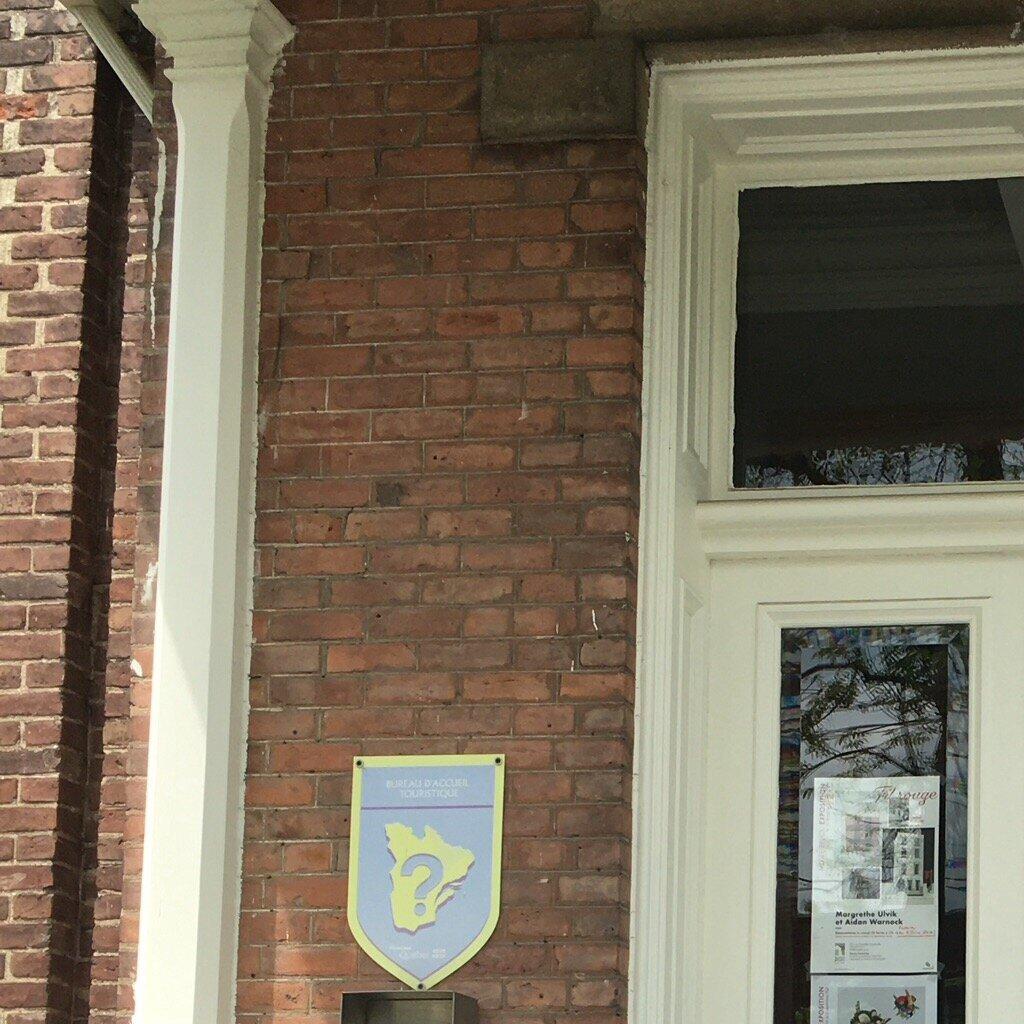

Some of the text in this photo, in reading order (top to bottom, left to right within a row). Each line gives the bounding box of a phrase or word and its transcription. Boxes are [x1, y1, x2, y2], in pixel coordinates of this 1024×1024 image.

[386, 778, 469, 789] BUREAU D'ACCUEIL
[399, 789, 460, 799] TOURISTIQUE
[898, 790, 938, 806] rouge
[835, 910, 898, 919] Margrethe Ulvik
